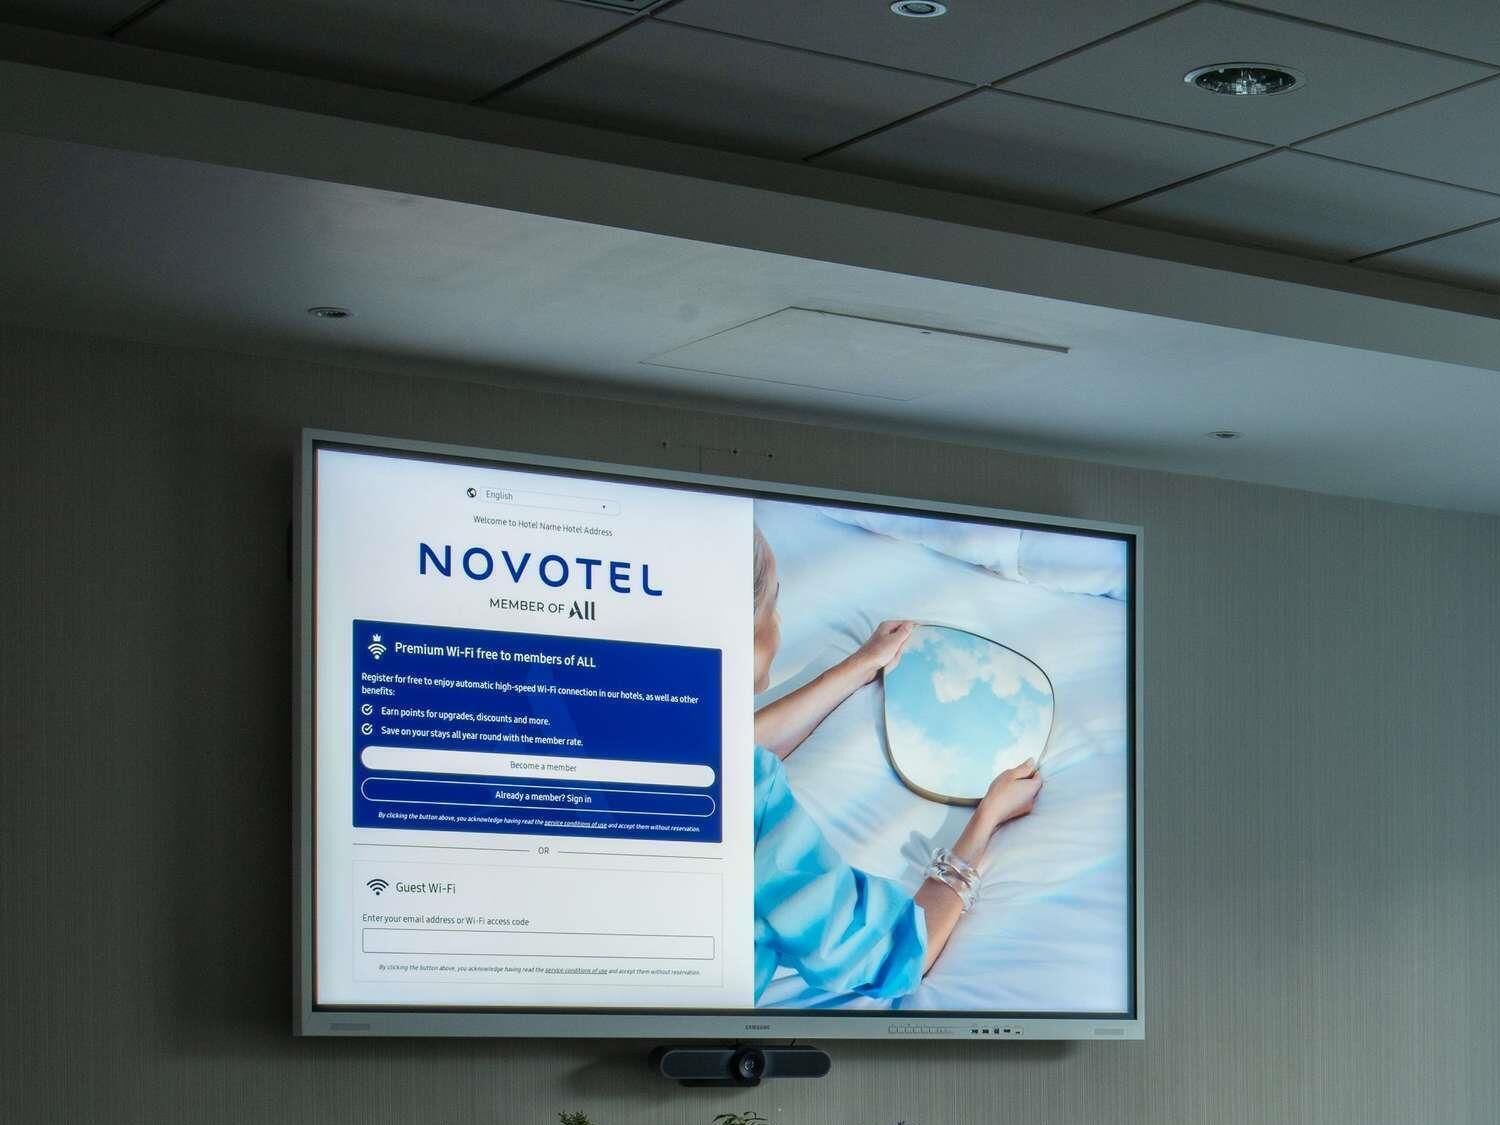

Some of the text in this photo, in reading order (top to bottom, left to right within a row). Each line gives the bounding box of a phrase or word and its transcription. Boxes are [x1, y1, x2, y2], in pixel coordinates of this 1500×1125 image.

[486, 490, 513, 501] English
[474, 515, 613, 537] Welcome to Hotel Name Hotel Address
[420, 543, 662, 596] NOVOTEL
[490, 598, 544, 612] MEMBER
[548, 603, 565, 613] OF
[396, 642, 596, 667] Premium Wi-Fi free to members of ALL
[362, 673, 393, 683] Register
[395, 675, 407, 683] for
[408, 675, 422, 685] free
[434, 678, 454, 688] enjoy
[456, 679, 493, 689] automatic
[496, 682, 535, 692] high-speed
[538, 685, 557, 694] Wi-Fi
[558, 687, 597, 696] connection
[599, 689, 606, 697] in
[621, 691, 644, 701] hotels,
[645, 693, 653, 701] as
[655, 693, 669, 702] well
[680, 695, 699, 704] other
[362, 686, 395, 696] benefits:
[381, 707, 550, 726] Earn points for upgrades, discounts and more.
[381, 726, 583, 746] Save on your stays all year round with the member rate.
[510, 761, 539, 770] Become
[546, 764, 577, 772] member
[495, 791, 523, 801] Already
[531, 792, 565, 802] member?
[567, 794, 583, 804] Sign
[585, 795, 592, 803] in
[387, 812, 407, 820] clicking
[419, 813, 437, 821] button
[468, 816, 502, 824] acknowledge
[504, 817, 521, 825] having
[618, 822, 635, 830] accept
[396, 882, 456, 894] Guest Wi-Fi
[363, 914, 382, 922] Enter
[384, 915, 401, 924] your
[403, 915, 424, 923] email
[426, 915, 455, 924] address
[512, 918, 529, 926] code
